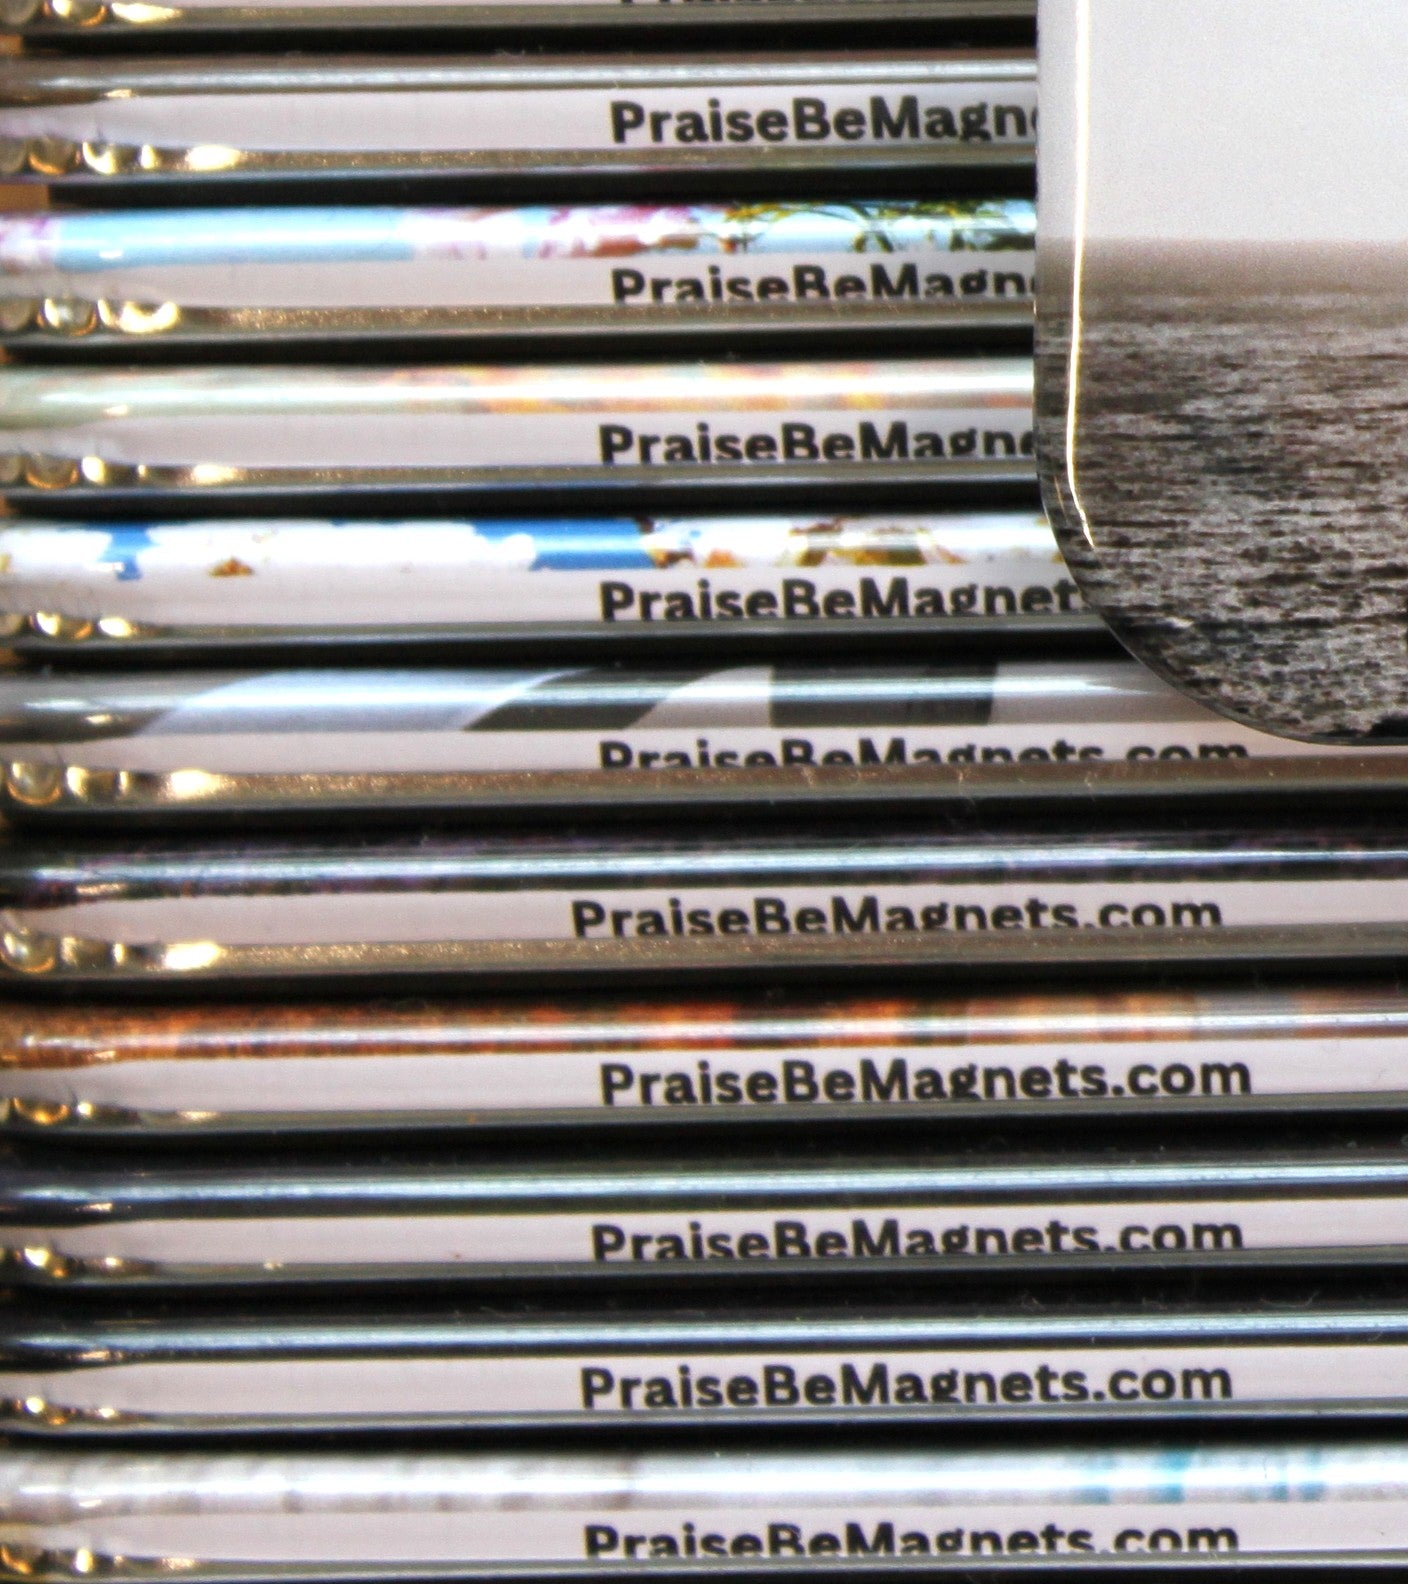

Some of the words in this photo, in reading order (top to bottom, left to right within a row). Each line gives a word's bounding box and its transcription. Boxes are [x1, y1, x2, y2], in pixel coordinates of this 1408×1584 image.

[611, 95, 1036, 143] PraiseBeMagn
[612, 264, 1036, 304] PraiseBeMagn
[599, 422, 1036, 466] PraiseBeMagn
[599, 737, 1250, 768] PraiseBeMagnetscom
[572, 896, 1223, 939] PraiseBeMagnets.com
[600, 1058, 1253, 1105] PraiseBeMagnets.com
[591, 1217, 1243, 1263] PraiseBeMagnets.com
[581, 1361, 1233, 1409] PraiseBeMagnets.com
